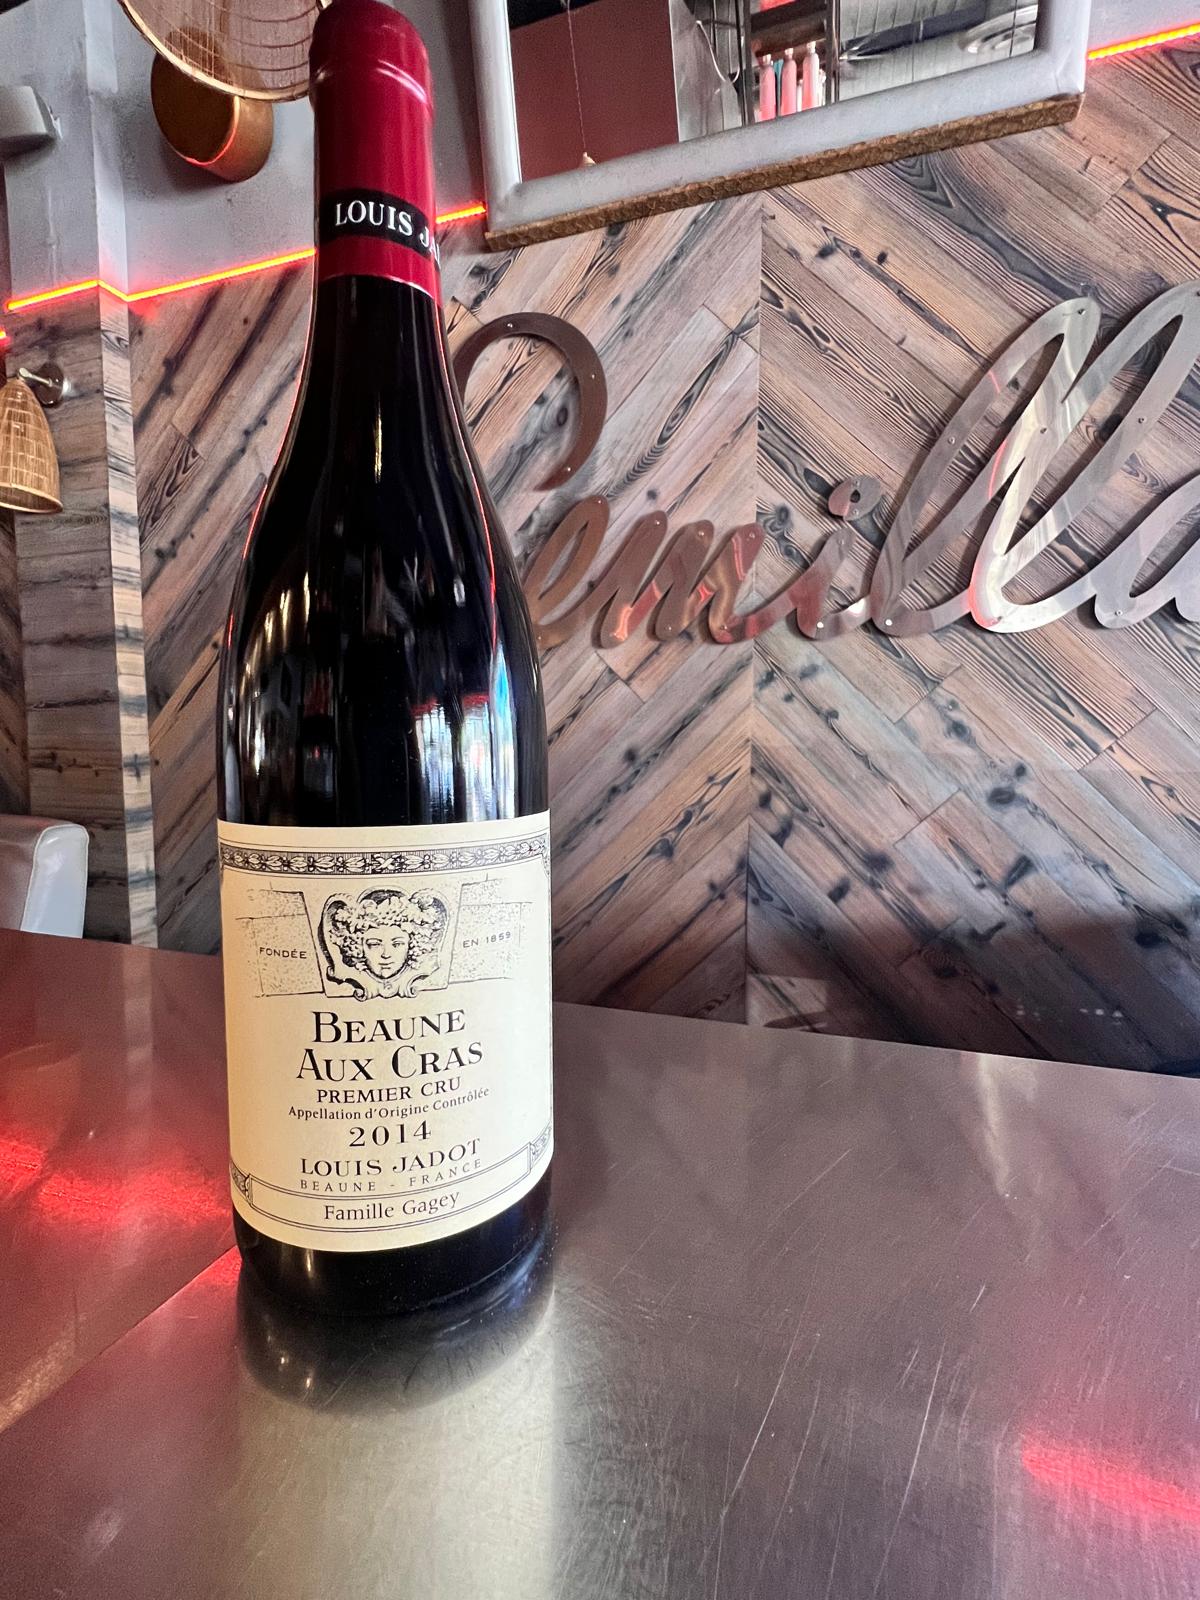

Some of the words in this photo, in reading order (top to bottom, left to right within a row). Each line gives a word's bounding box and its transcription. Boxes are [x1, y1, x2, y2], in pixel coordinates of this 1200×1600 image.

[335, 200, 413, 236] LOUIS
[420, 226, 440, 269] JA
[259, 946, 307, 960] FONDÉE
[462, 938, 480, 949] EN
[485, 930, 512, 945] 1859
[312, 1009, 465, 1043] BEAUNE
[296, 1048, 375, 1082] AUX
[391, 1042, 483, 1079] CRAS
[288, 1106, 361, 1121] Appellation
[365, 1102, 429, 1120] d'Origine
[432, 1087, 490, 1111] Contrôlée
[316, 1086, 413, 1104] PREMIER
[420, 1076, 462, 1097] CRU
[349, 1120, 432, 1147] 2014
[300, 1158, 382, 1177] LOUIS
[392, 1137, 481, 1173] JADOT
[300, 1179, 376, 1193] BEAUNE
[409, 1158, 482, 1187] FRANCE
[324, 1203, 394, 1221] Famille
[402, 1191, 460, 1215] Gagey
